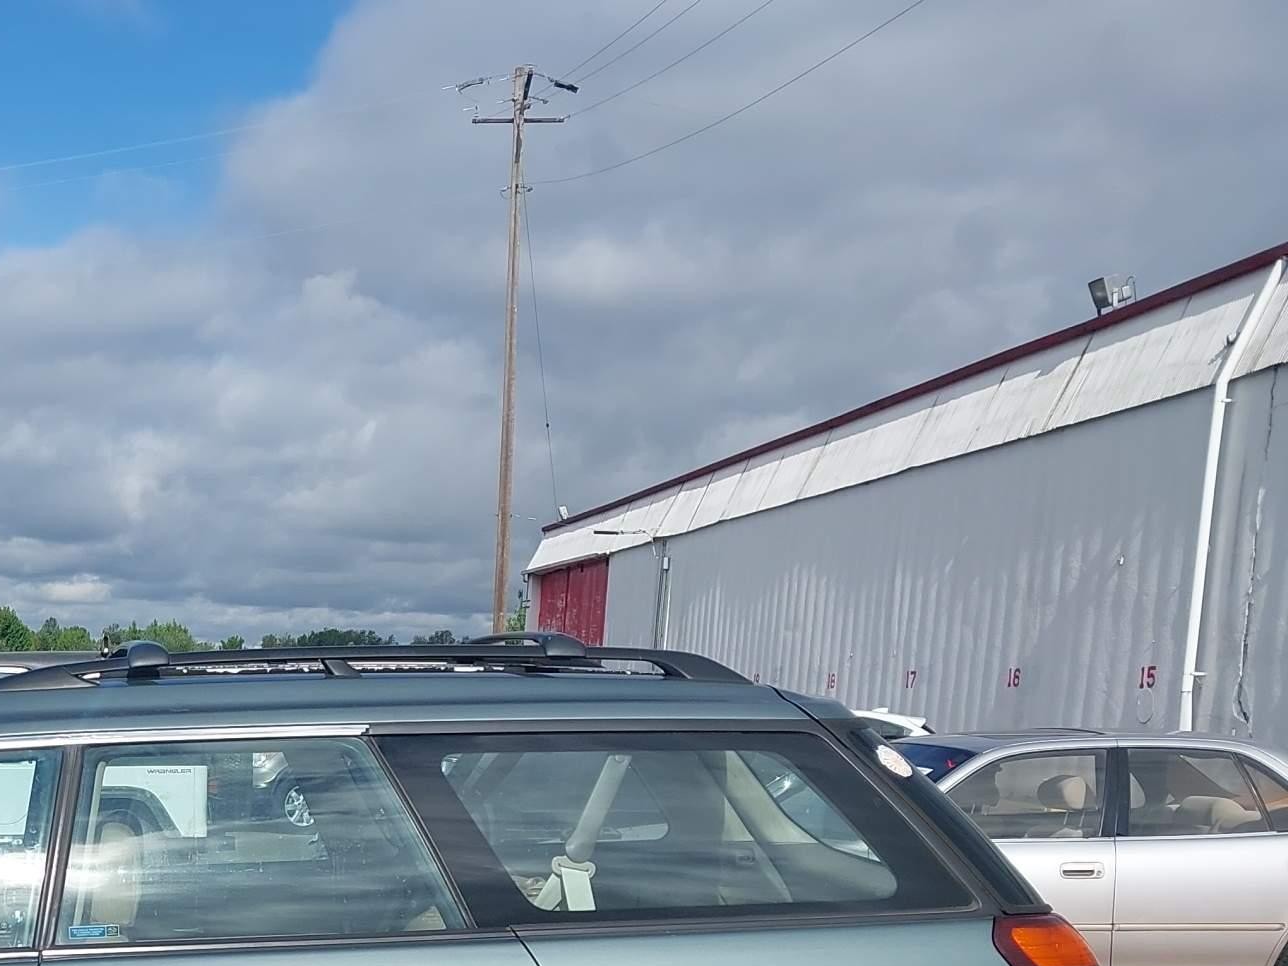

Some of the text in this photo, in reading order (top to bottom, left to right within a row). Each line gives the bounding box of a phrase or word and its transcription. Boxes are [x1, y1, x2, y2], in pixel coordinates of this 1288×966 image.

[905, 670, 917, 688] 17
[1007, 667, 1021, 688] 16
[1139, 665, 1156, 689] 15
